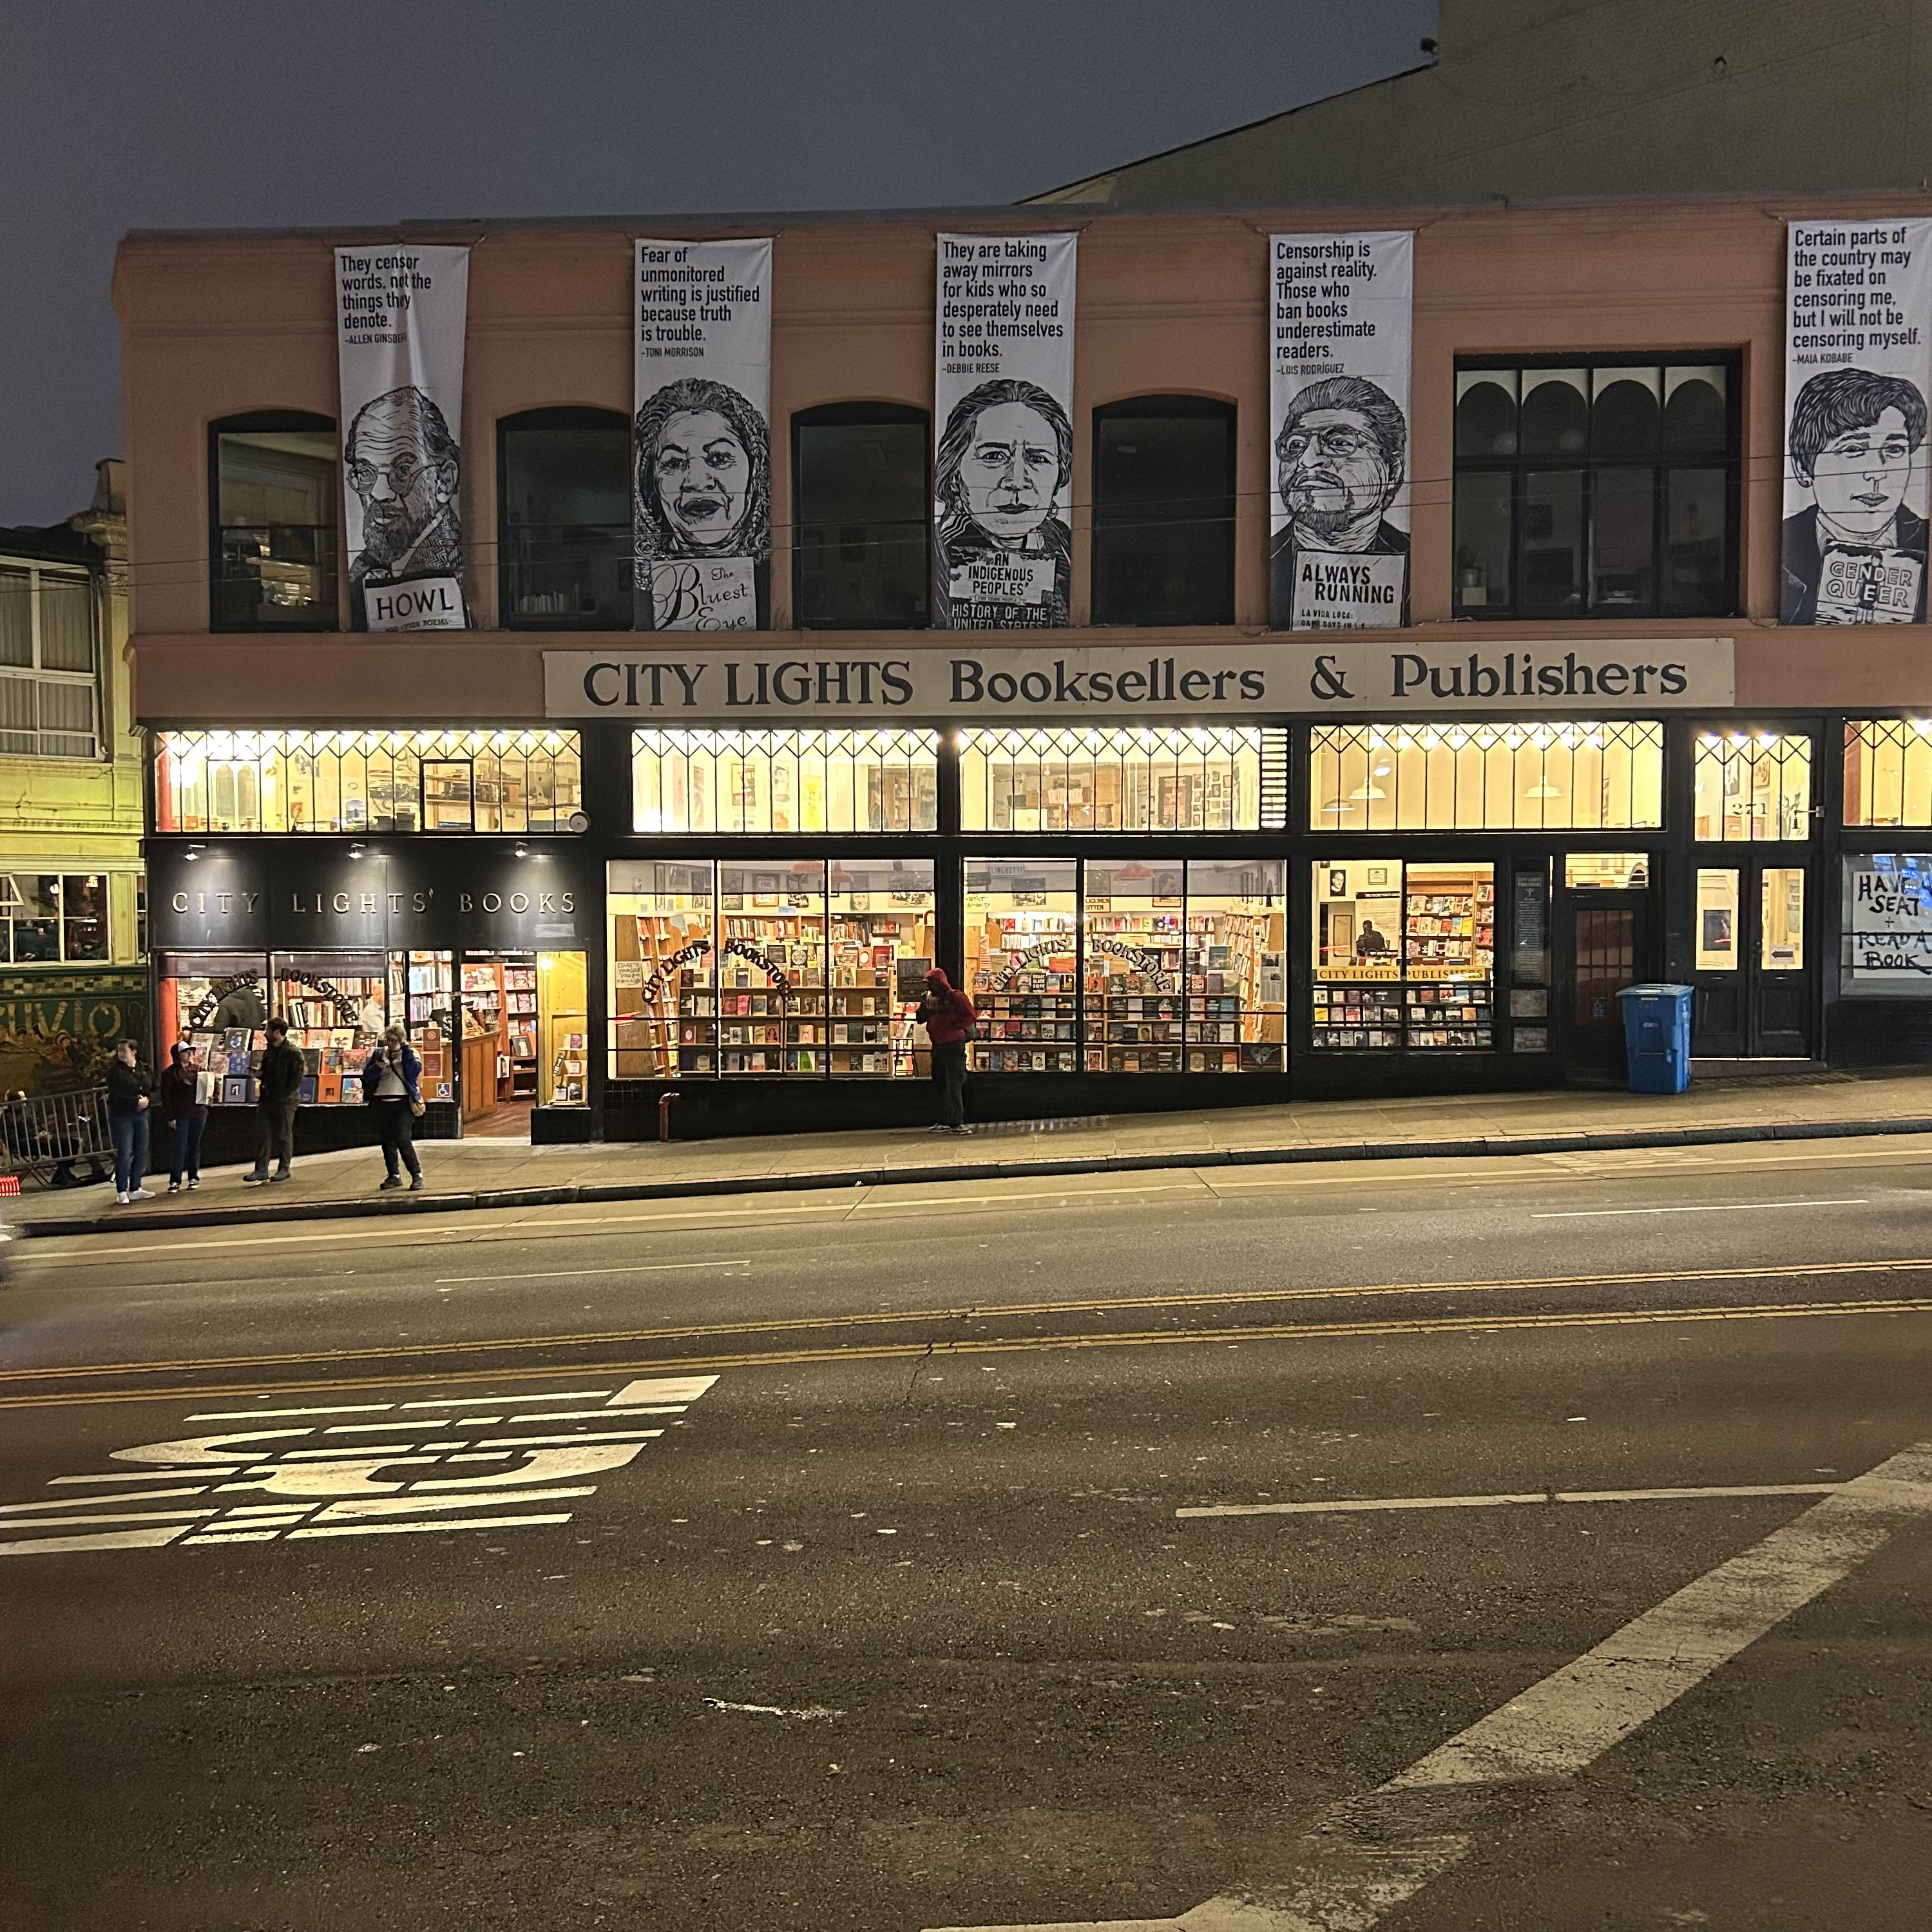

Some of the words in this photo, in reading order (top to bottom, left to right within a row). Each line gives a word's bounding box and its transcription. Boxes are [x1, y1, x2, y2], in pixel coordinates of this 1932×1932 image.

[1795, 229, 1846, 246] Certain
[1851, 228, 1887, 249] parts
[1892, 227, 1907, 244] of
[642, 247, 671, 263] Fear
[674, 247, 688, 263] of
[943, 242, 975, 262] They
[979, 245, 1000, 258] are
[1004, 240, 1047, 262] taking
[1277, 241, 1353, 262] Censorship
[1359, 240, 1370, 257] is
[1794, 250, 1817, 267] the
[1821, 249, 1876, 269] country
[1881, 251, 1911, 269] may
[341, 256, 371, 274] They
[376, 256, 420, 269] censor
[642, 265, 725, 282] unmonitored
[943, 265, 978, 282] away
[982, 261, 1033, 277] mirrors
[1277, 262, 1327, 283] against
[1332, 260, 1377, 281] reality.
[390, 273, 409, 288] not
[412, 273, 432, 289] the
[1794, 270, 1812, 287] be
[1816, 268, 1864, 286] fixated
[1870, 272, 1886, 285] on
[642, 285, 686, 306] writing
[691, 285, 702, 302] is
[705, 285, 760, 306] justified
[943, 281, 962, 298] for
[966, 280, 994, 298] kids
[999, 280, 1026, 297] who
[1031, 284, 1047, 296] so
[1276, 282, 1317, 299] Those
[1321, 281, 1350, 297] who
[343, 294, 383, 312] things
[387, 292, 410, 309] they
[1793, 289, 1865, 310] censoring
[1870, 292, 1896, 306] me,
[642, 305, 696, 321] because
[700, 304, 731, 321] truth
[943, 300, 1021, 321] desperately
[1026, 300, 1058, 317] need
[1277, 302, 1301, 319] ban
[1306, 301, 1348, 318] books
[1793, 311, 1816, 328] but
[1821, 310, 1824, 327] I
[1830, 309, 1855, 326] will
[1859, 309, 1882, 325] not
[1886, 308, 1903, 325] be
[344, 312, 392, 329] denote.
[942, 321, 955, 337] to
[959, 325, 982, 337] see
[986, 320, 1064, 337] themselves
[1277, 321, 1375, 339] underestimate
[642, 325, 652, 341] is
[656, 325, 706, 341] trouble.
[1793, 329, 1864, 350] censoring
[1870, 327, 1921, 349] myself.
[664, 348, 703, 357] MORRISON
[942, 341, 954, 357] in
[959, 340, 1002, 357] books.
[1277, 341, 1334, 359] readers.
[1820, 353, 1853, 363] KOBABE
[976, 363, 1000, 373] REESE
[1301, 362, 1344, 375] RODRÍGUEZ
[994, 553, 1009, 566] AN
[711, 567, 734, 580] The
[968, 566, 1033, 582] INDIGENOUS
[1302, 564, 1371, 585] ALWAYS
[1830, 561, 1912, 587] GENDER
[651, 562, 748, 630] Bluest
[1315, 583, 1394, 604] RUNNING
[1826, 579, 1909, 607] QUEER
[376, 588, 454, 620] HOWL
[952, 604, 998, 619] HISTORY
[1005, 606, 1018, 620] OF
[1026, 607, 1047, 620] THE
[1301, 609, 1310, 617] LA
[422, 618, 449, 627] POEMS
[696, 607, 747, 631] Eye
[584, 662, 708, 706] CITY
[724, 662, 913, 706] LIGHTS
[949, 658, 1265, 703] Booksellers
[1310, 655, 1355, 700] &
[1390, 653, 1688, 698] Publishers
[1732, 803, 1768, 815] 271
[1858, 875, 1909, 901] HAVE
[173, 892, 259, 913] CITY
[459, 892, 575, 914] BOOKS
[1869, 895, 1919, 916] SEAT
[1859, 932, 1910, 950] READ
[656, 944, 711, 975] LIGHTS
[724, 941, 796, 1002] BOOKSTORE
[1013, 939, 1067, 968] LIGHTS
[1091, 939, 1171, 992] BOOKSTORE
[1863, 952, 1932, 975] BOOK
[1320, 970, 1348, 979] CITY
[1353, 970, 1399, 979] LIGHTS
[280, 968, 359, 1026] BOOKSTORE
